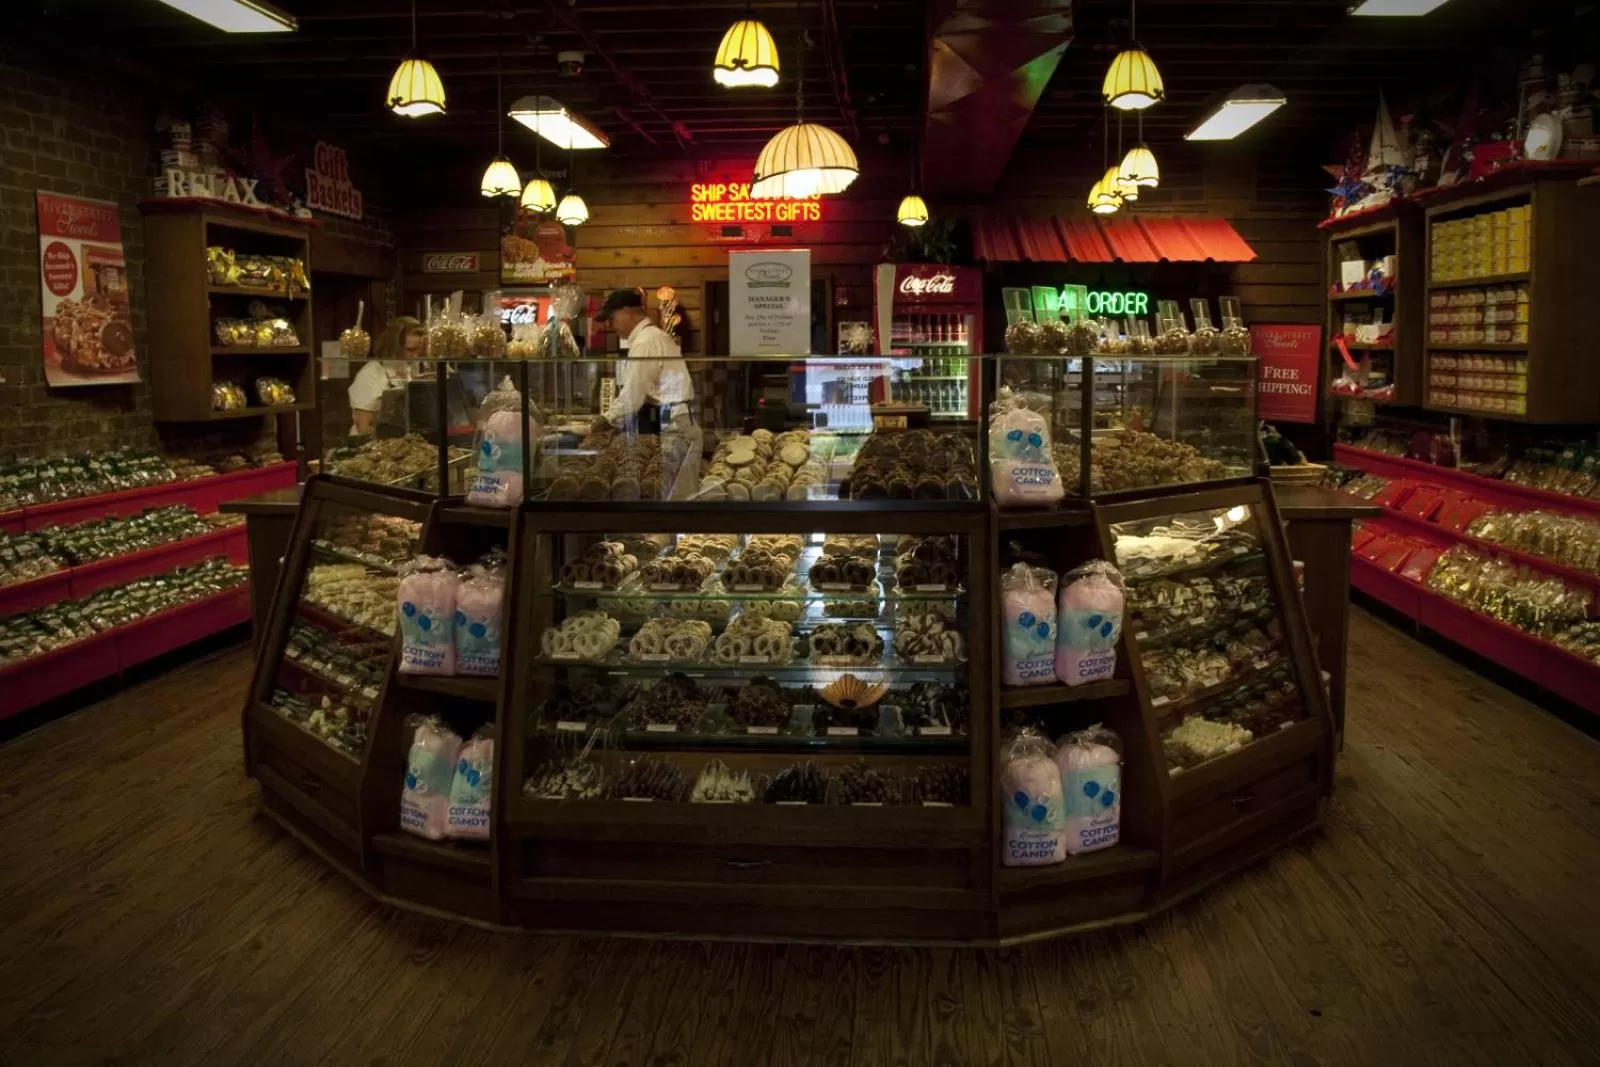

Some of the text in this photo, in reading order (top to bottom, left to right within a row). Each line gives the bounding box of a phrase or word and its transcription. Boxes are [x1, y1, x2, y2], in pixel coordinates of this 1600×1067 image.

[315, 144, 348, 184] Gift
[166, 168, 265, 209] RELAX
[308, 173, 362, 218] Baskets
[691, 183, 727, 202] SHIP
[691, 202, 821, 221] SWEETEST GIFTS
[900, 274, 956, 296] Coca-Cola
[1087, 291, 1148, 315] ORDER
[1263, 365, 1300, 380] FREE
[1012, 467, 1054, 477] COTTON
[1015, 476, 1052, 486] CANDY
[404, 645, 446, 659] COTTON
[404, 654, 443, 668] CANDY
[1016, 659, 1056, 670] COTTO
[1078, 656, 1114, 669] COTTON
[1079, 664, 1112, 678] CANDY
[400, 807, 428, 820] OTTON
[449, 807, 490, 817] COTTON
[401, 817, 427, 829] ANDY
[448, 816, 487, 827] CANDY
[1080, 823, 1119, 838] COTTON
[1008, 839, 1058, 850] COTTON
[1082, 833, 1118, 848] CANDY
[1011, 848, 1056, 859] CANDY
